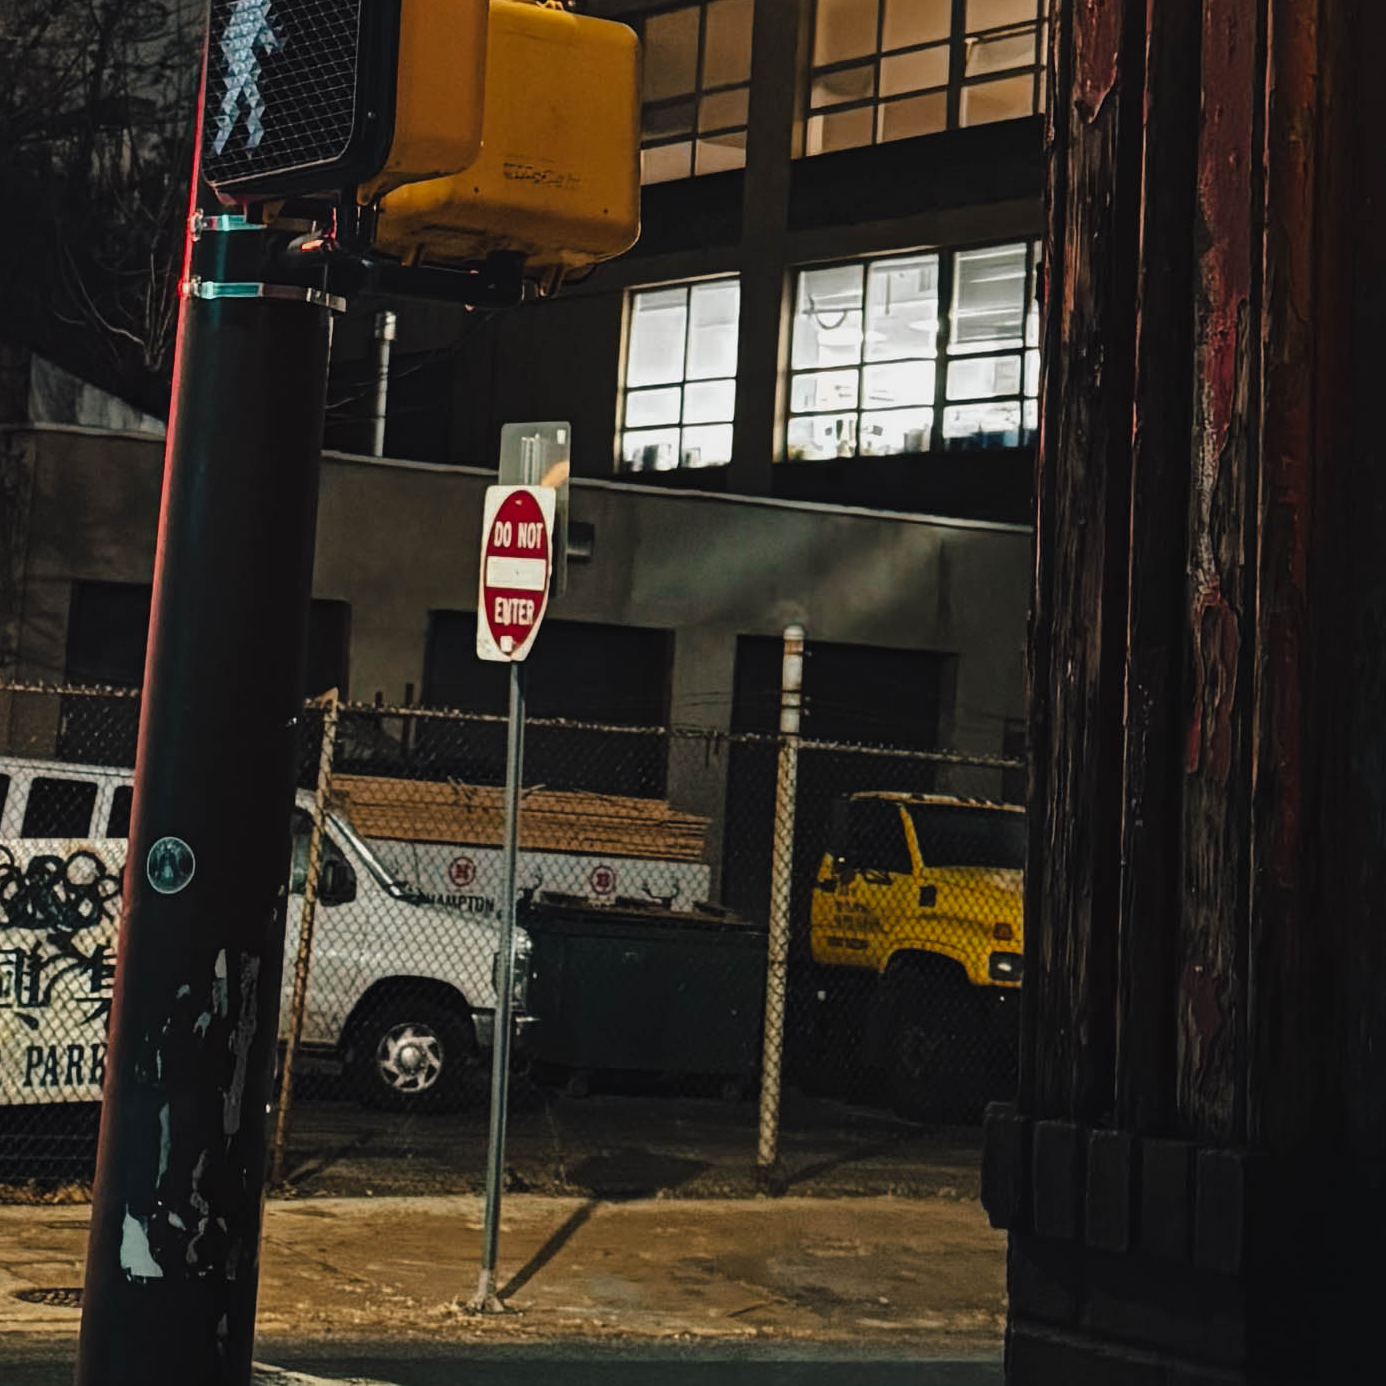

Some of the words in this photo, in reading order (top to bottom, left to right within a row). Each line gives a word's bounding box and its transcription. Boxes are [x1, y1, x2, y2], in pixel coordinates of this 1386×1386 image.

[493, 520, 513, 548] DO
[517, 521, 544, 549] NOT
[493, 596, 535, 627] ENTER
